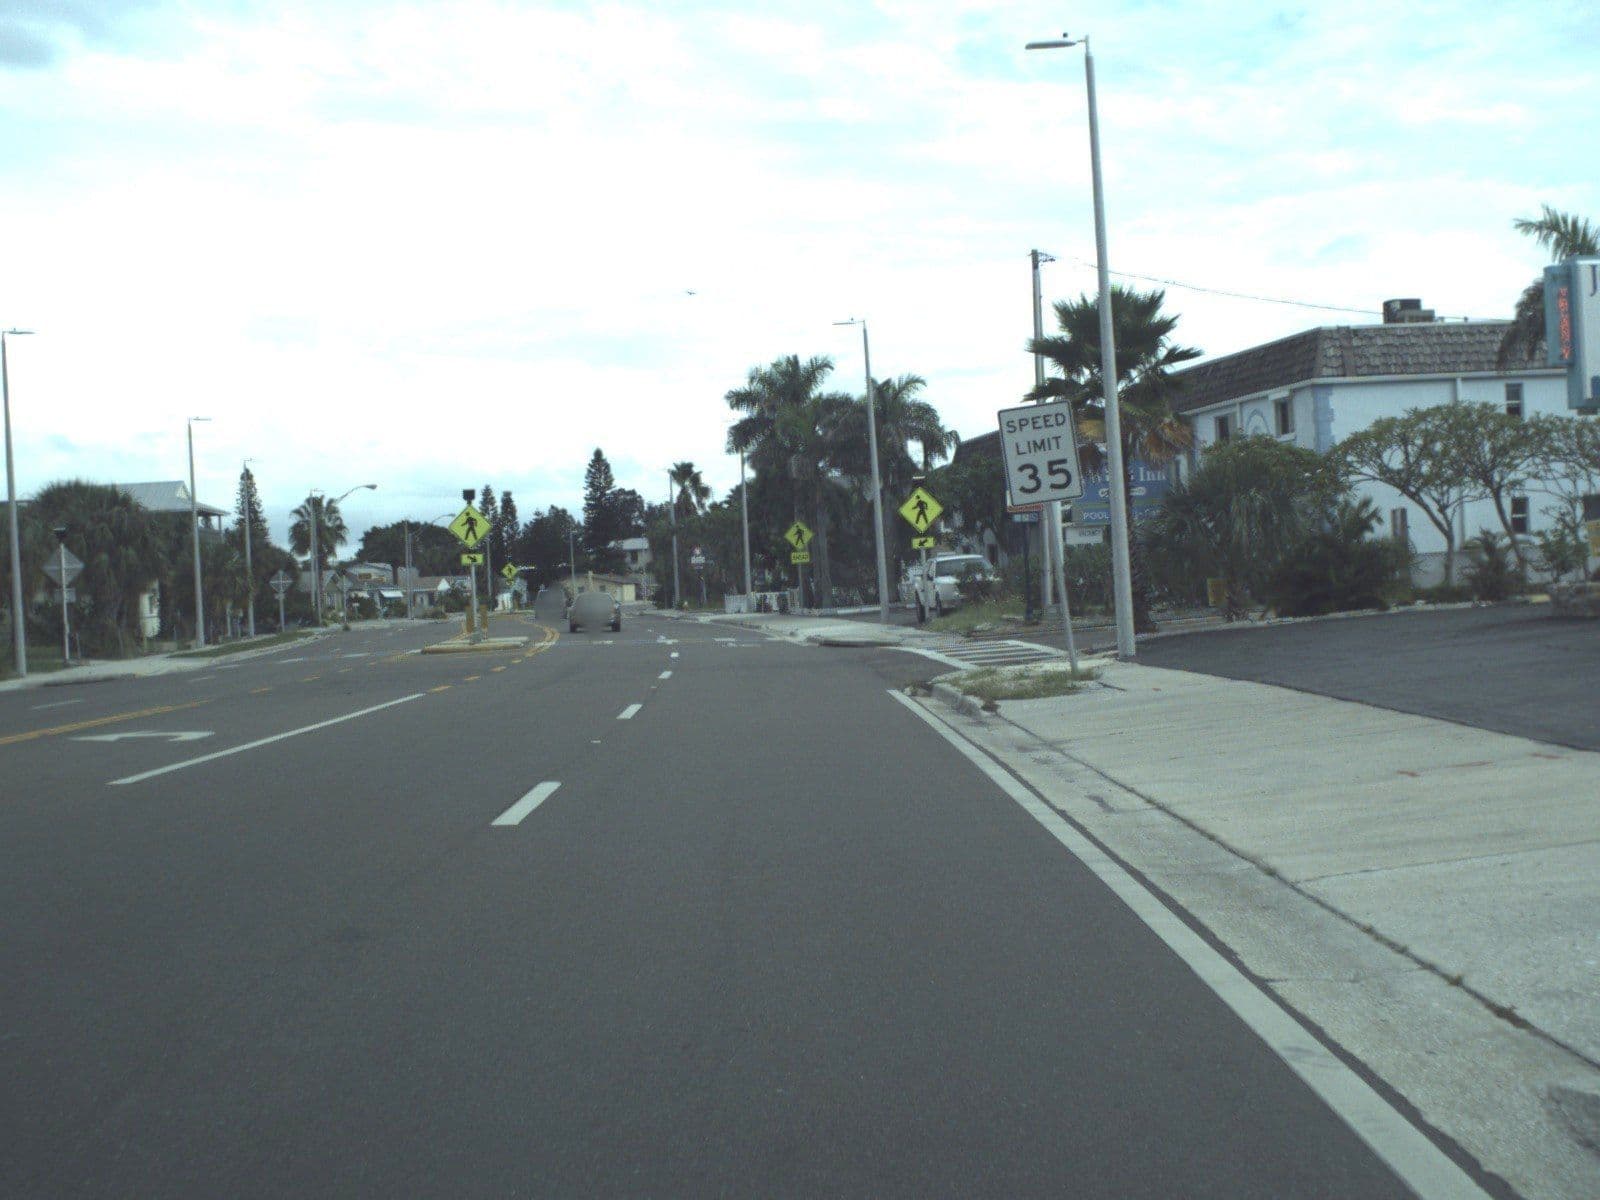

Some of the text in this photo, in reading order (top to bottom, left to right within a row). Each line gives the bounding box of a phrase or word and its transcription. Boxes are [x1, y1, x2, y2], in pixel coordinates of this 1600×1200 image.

[1006, 413, 1066, 433] SPEED
[1015, 436, 1062, 455] LIMIT
[1017, 458, 1072, 494] 35
